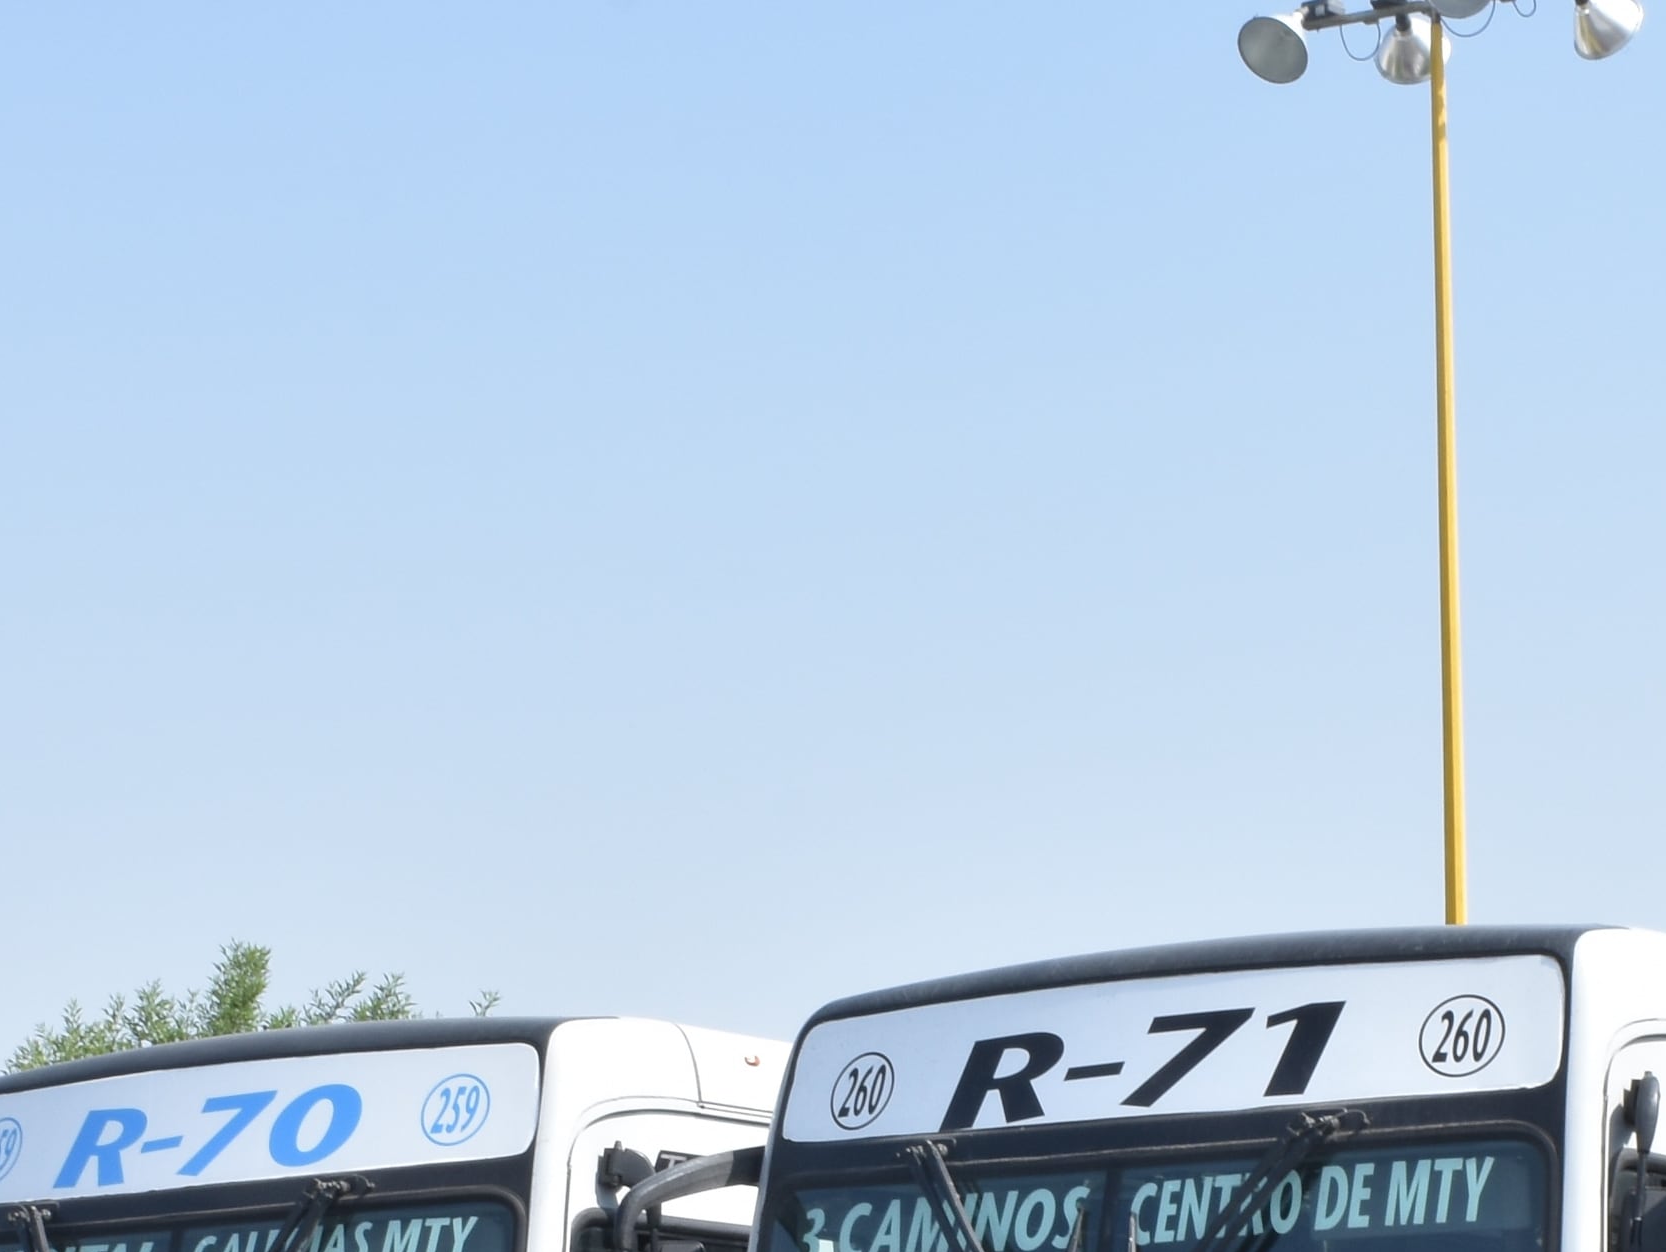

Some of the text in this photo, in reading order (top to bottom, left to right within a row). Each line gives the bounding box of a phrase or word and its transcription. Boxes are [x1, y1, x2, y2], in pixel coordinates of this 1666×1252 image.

[940, 1000, 1347, 1132] R-71
[1431, 1012, 1493, 1064] 260
[429, 1085, 480, 1134] 259
[839, 1066, 886, 1117] 260
[53, 1083, 363, 1189] R-70
[1314, 1163, 1375, 1231] DE
[1384, 1156, 1495, 1226] MTY
